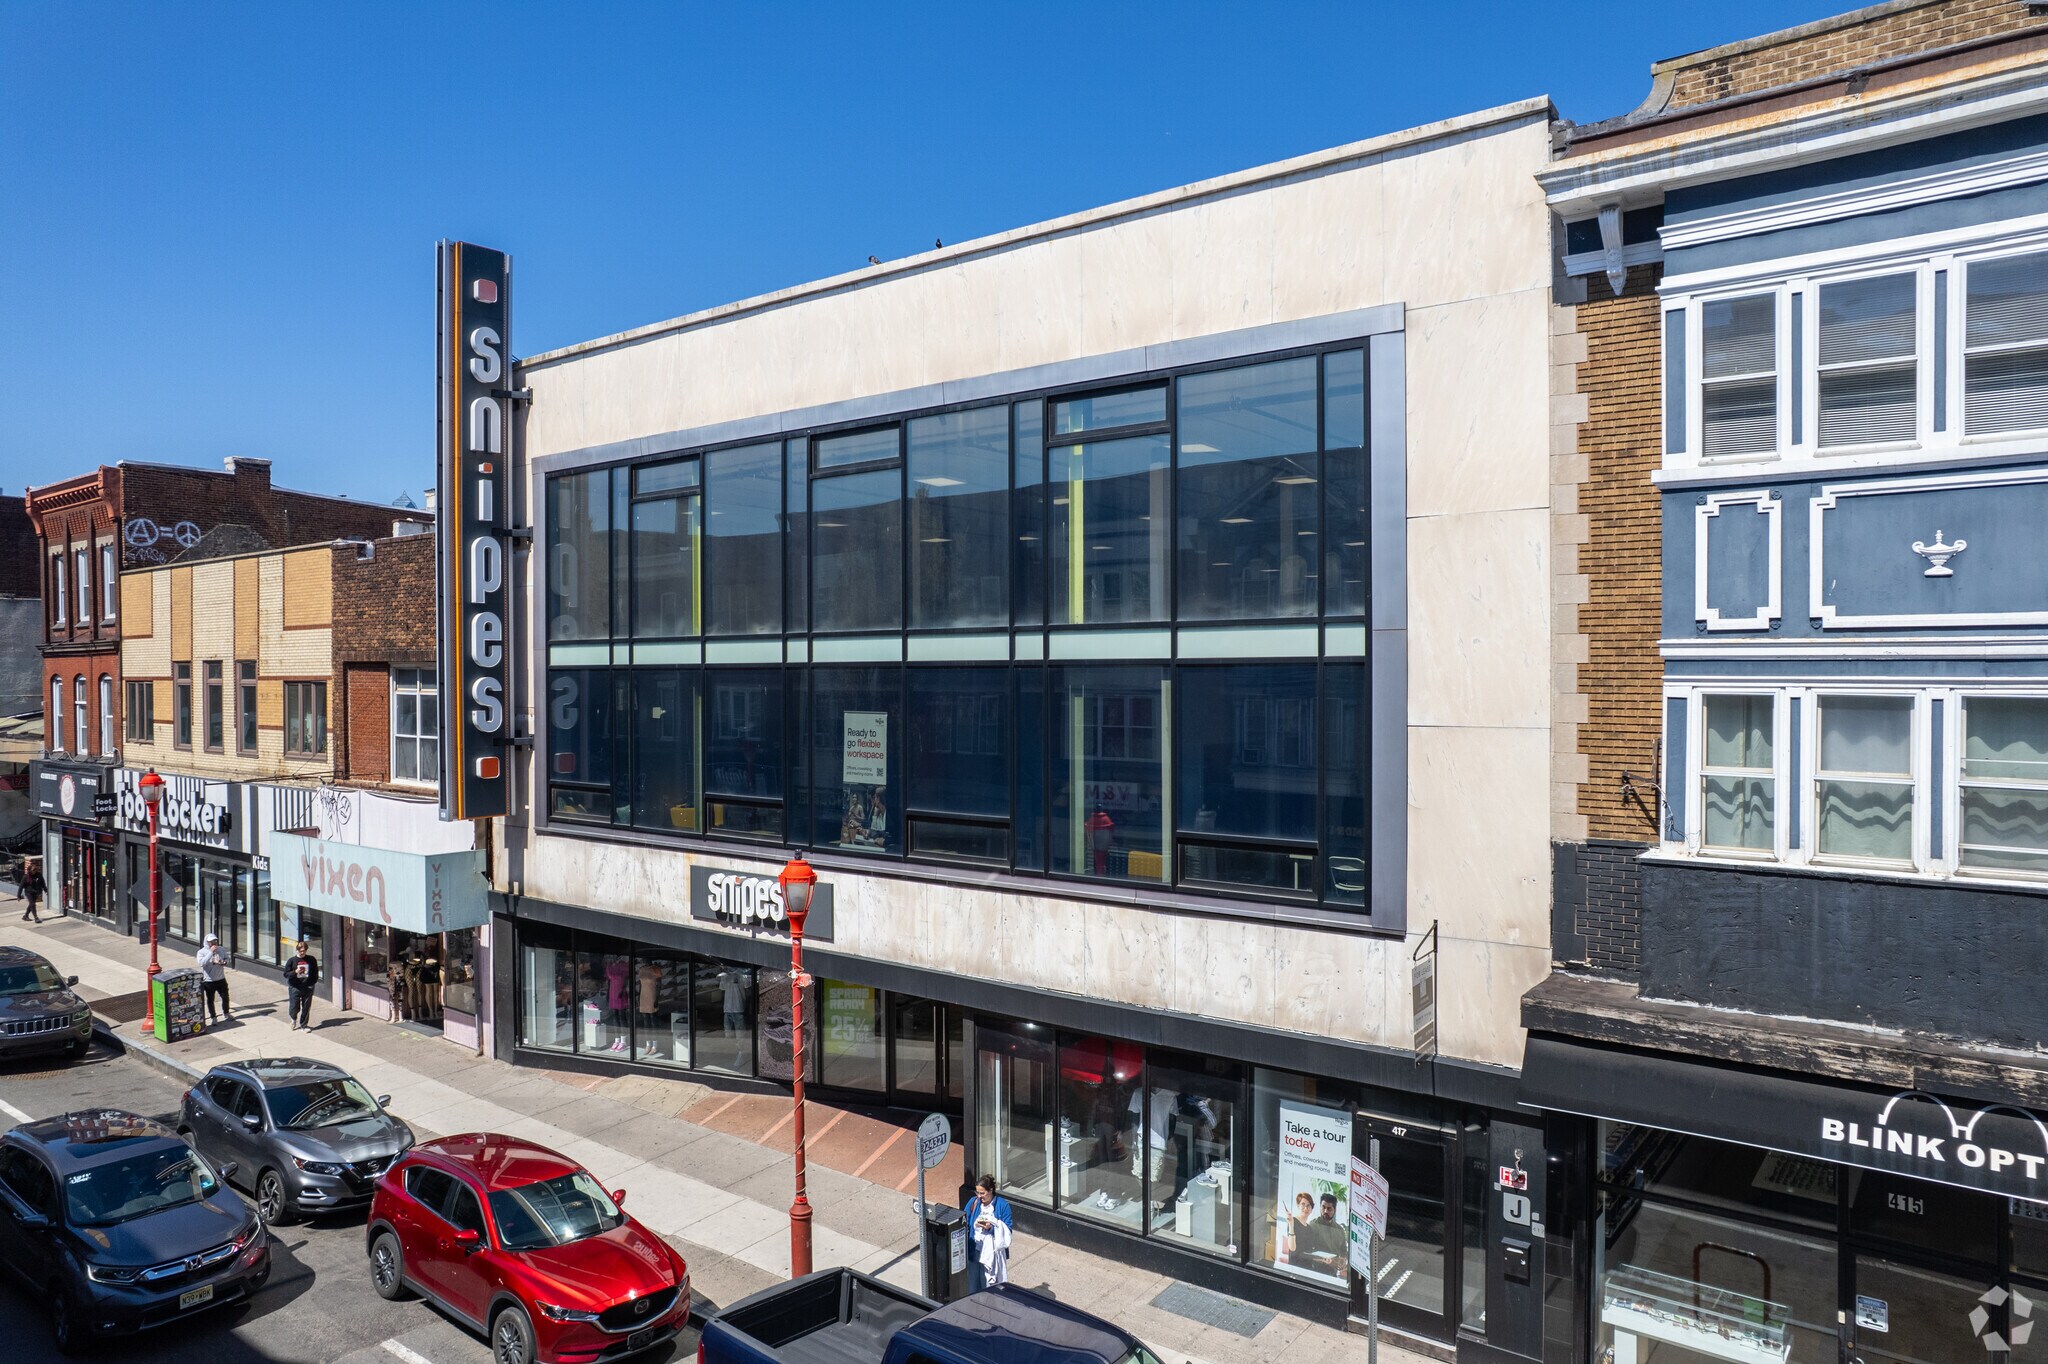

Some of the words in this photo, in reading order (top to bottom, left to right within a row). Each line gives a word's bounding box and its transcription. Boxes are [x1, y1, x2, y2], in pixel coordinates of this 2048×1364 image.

[470, 326, 502, 733] snipes
[847, 728, 869, 739] Ready
[869, 729, 877, 737] to
[847, 740, 856, 749] go
[857, 739, 881, 748] flexible
[847, 750, 884, 760] workspace
[117, 782, 150, 822] Foo
[159, 791, 222, 834] Locker
[252, 855, 268, 871] Kids
[301, 843, 392, 924] vixen
[432, 863, 444, 927] vixen
[708, 873, 785, 924] snipes
[829, 988, 869, 999] SPRING
[829, 999, 865, 1010] READY
[1285, 1120, 1311, 1136] Take
[1313, 1128, 1321, 1138] a
[1323, 1130, 1346, 1143] tour
[1392, 1126, 1407, 1137] 417
[1822, 1118, 1945, 1162] BLINK
[1284, 1135, 1315, 1152] today
[1293, 1160, 1313, 1171] meeting
[1314, 1165, 1330, 1174] rooms
[1302, 1156, 1329, 1167] coworking
[1510, 1200, 1521, 1218] J
[1889, 1193, 1923, 1215] 415
